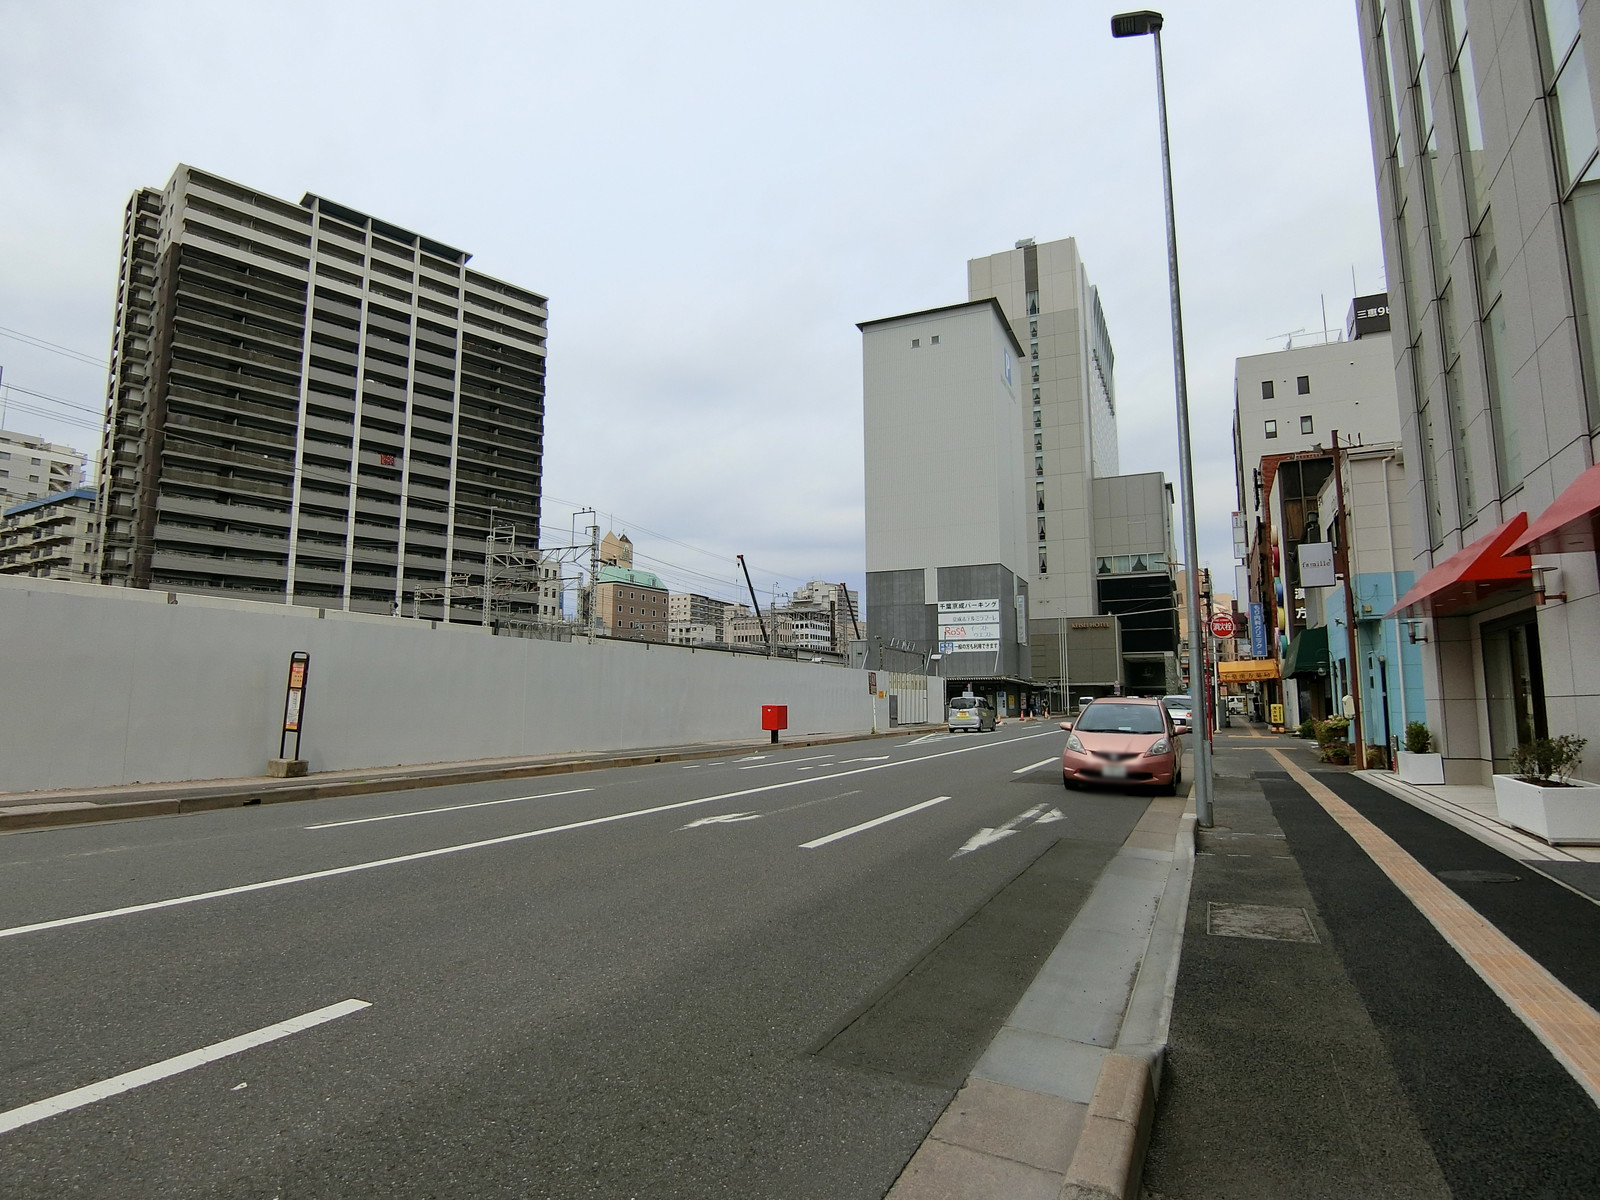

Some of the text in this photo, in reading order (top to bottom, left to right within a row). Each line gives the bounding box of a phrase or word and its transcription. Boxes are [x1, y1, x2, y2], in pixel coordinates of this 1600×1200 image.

[939, 601, 997, 610] 千葉京成パーキング
[1213, 622, 1232, 631] 消火栓
